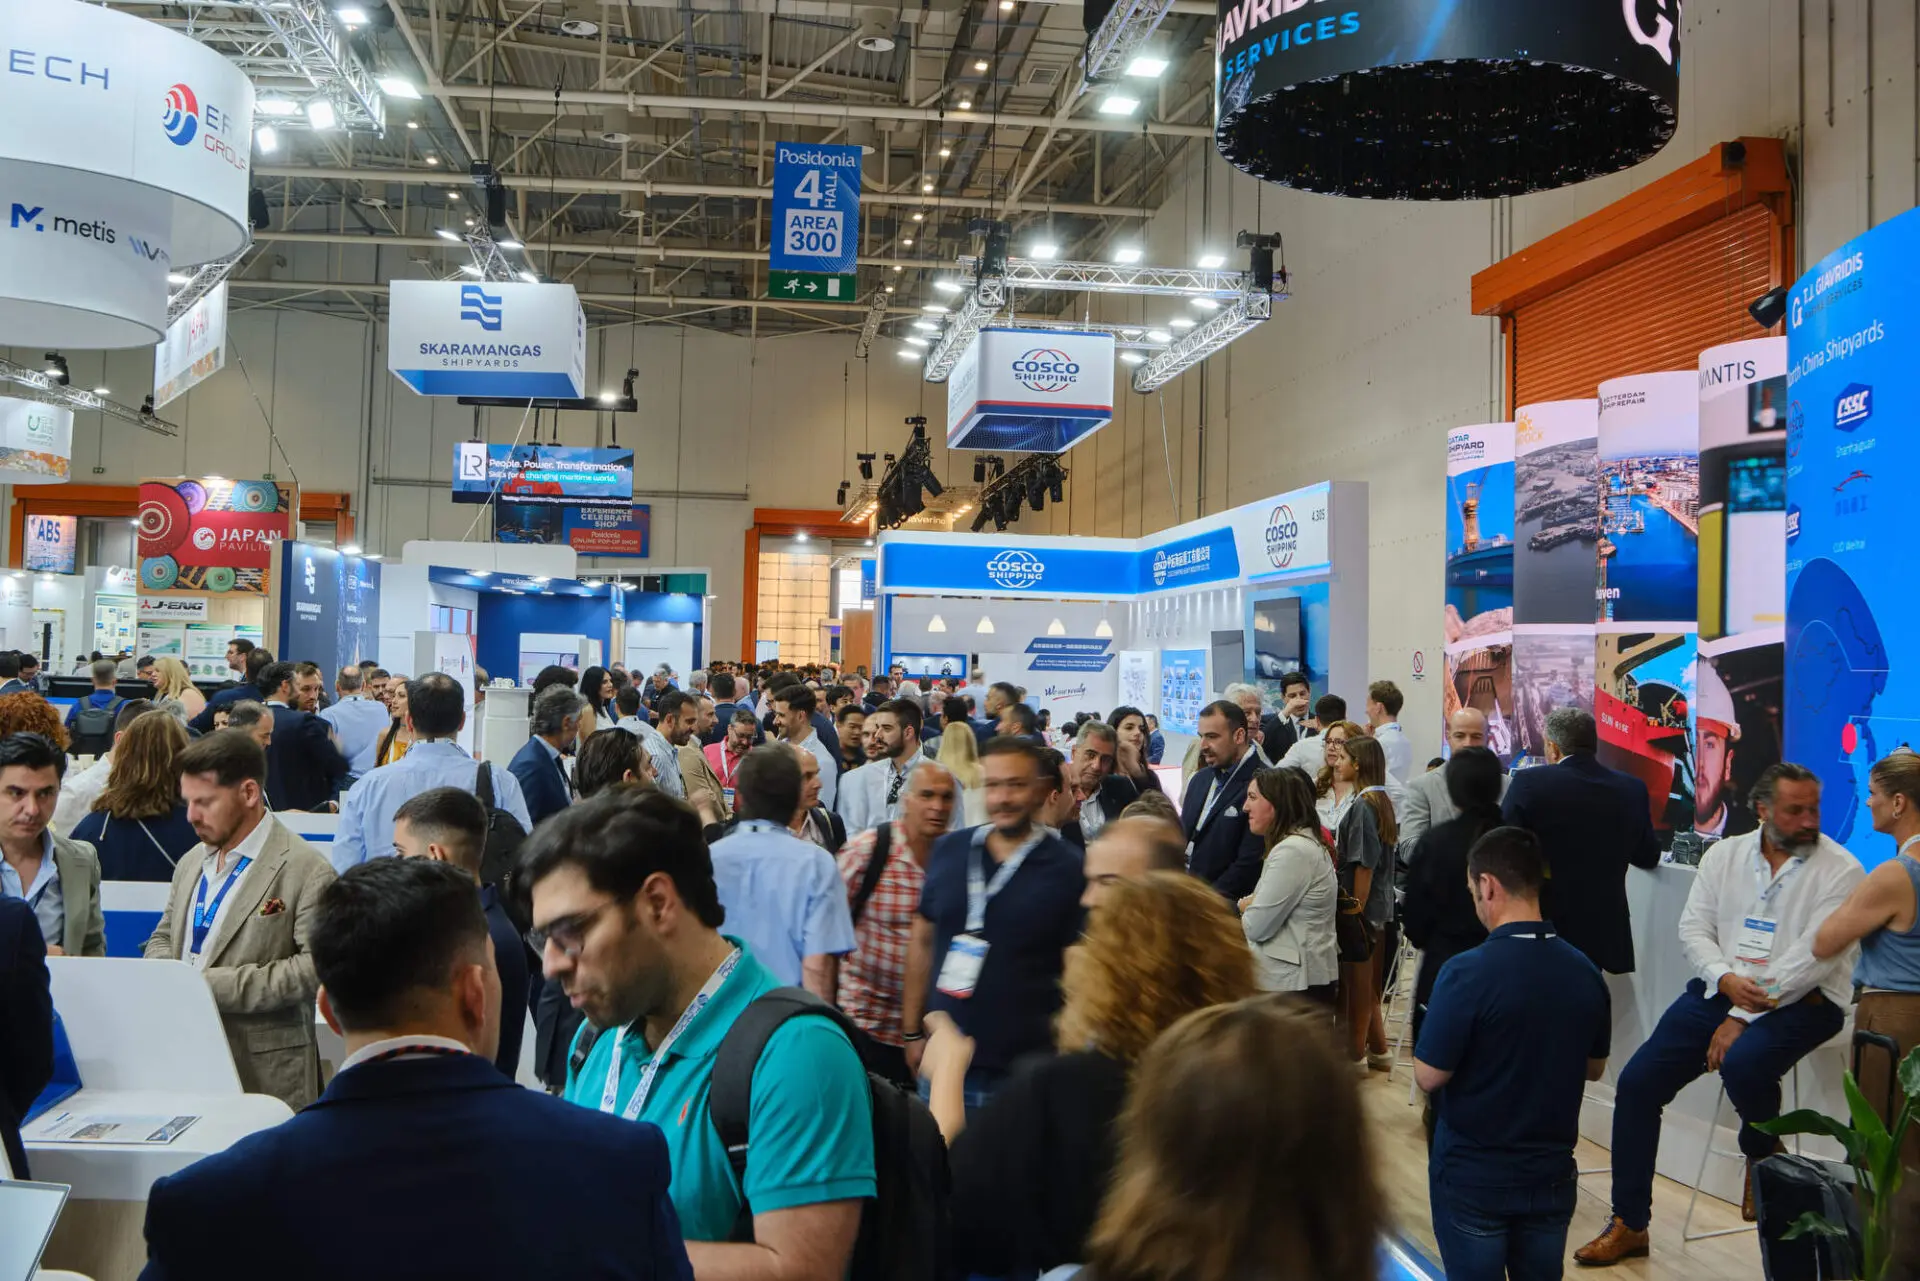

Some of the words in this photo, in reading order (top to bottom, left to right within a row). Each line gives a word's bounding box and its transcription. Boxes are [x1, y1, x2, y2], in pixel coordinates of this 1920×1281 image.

[1225, 12, 1361, 81] SERVICES
[9, 49, 108, 89] ECH
[779, 148, 856, 167] Posidonia
[794, 170, 823, 208] 4
[824, 171, 838, 208] HALL
[790, 215, 838, 230] AREA
[54, 216, 116, 244] metis
[790, 231, 836, 252] 300
[419, 343, 541, 357] SKARAMANGAS
[1802, 350, 1825, 377] China
[1826, 319, 1885, 362] Shipyards
[442, 358, 519, 368] SHIPYARDS
[1012, 361, 1080, 374] COSCO
[1015, 373, 1077, 383] SHIPPING
[489, 460, 522, 470] People.
[524, 460, 555, 469] Power.
[556, 461, 627, 472] Transformation.
[526, 472, 558, 481] changing
[581, 513, 632, 521] CELEBRATE
[37, 519, 61, 543] ABS
[220, 528, 281, 542] JAPAN
[1266, 521, 1298, 542] COSCO
[220, 542, 271, 552] PAVILIO
[1267, 540, 1297, 555] SHIPPING
[986, 561, 1045, 573] COSCO
[988, 571, 1043, 580] SHIPPING
[152, 601, 203, 610] J-ENG
